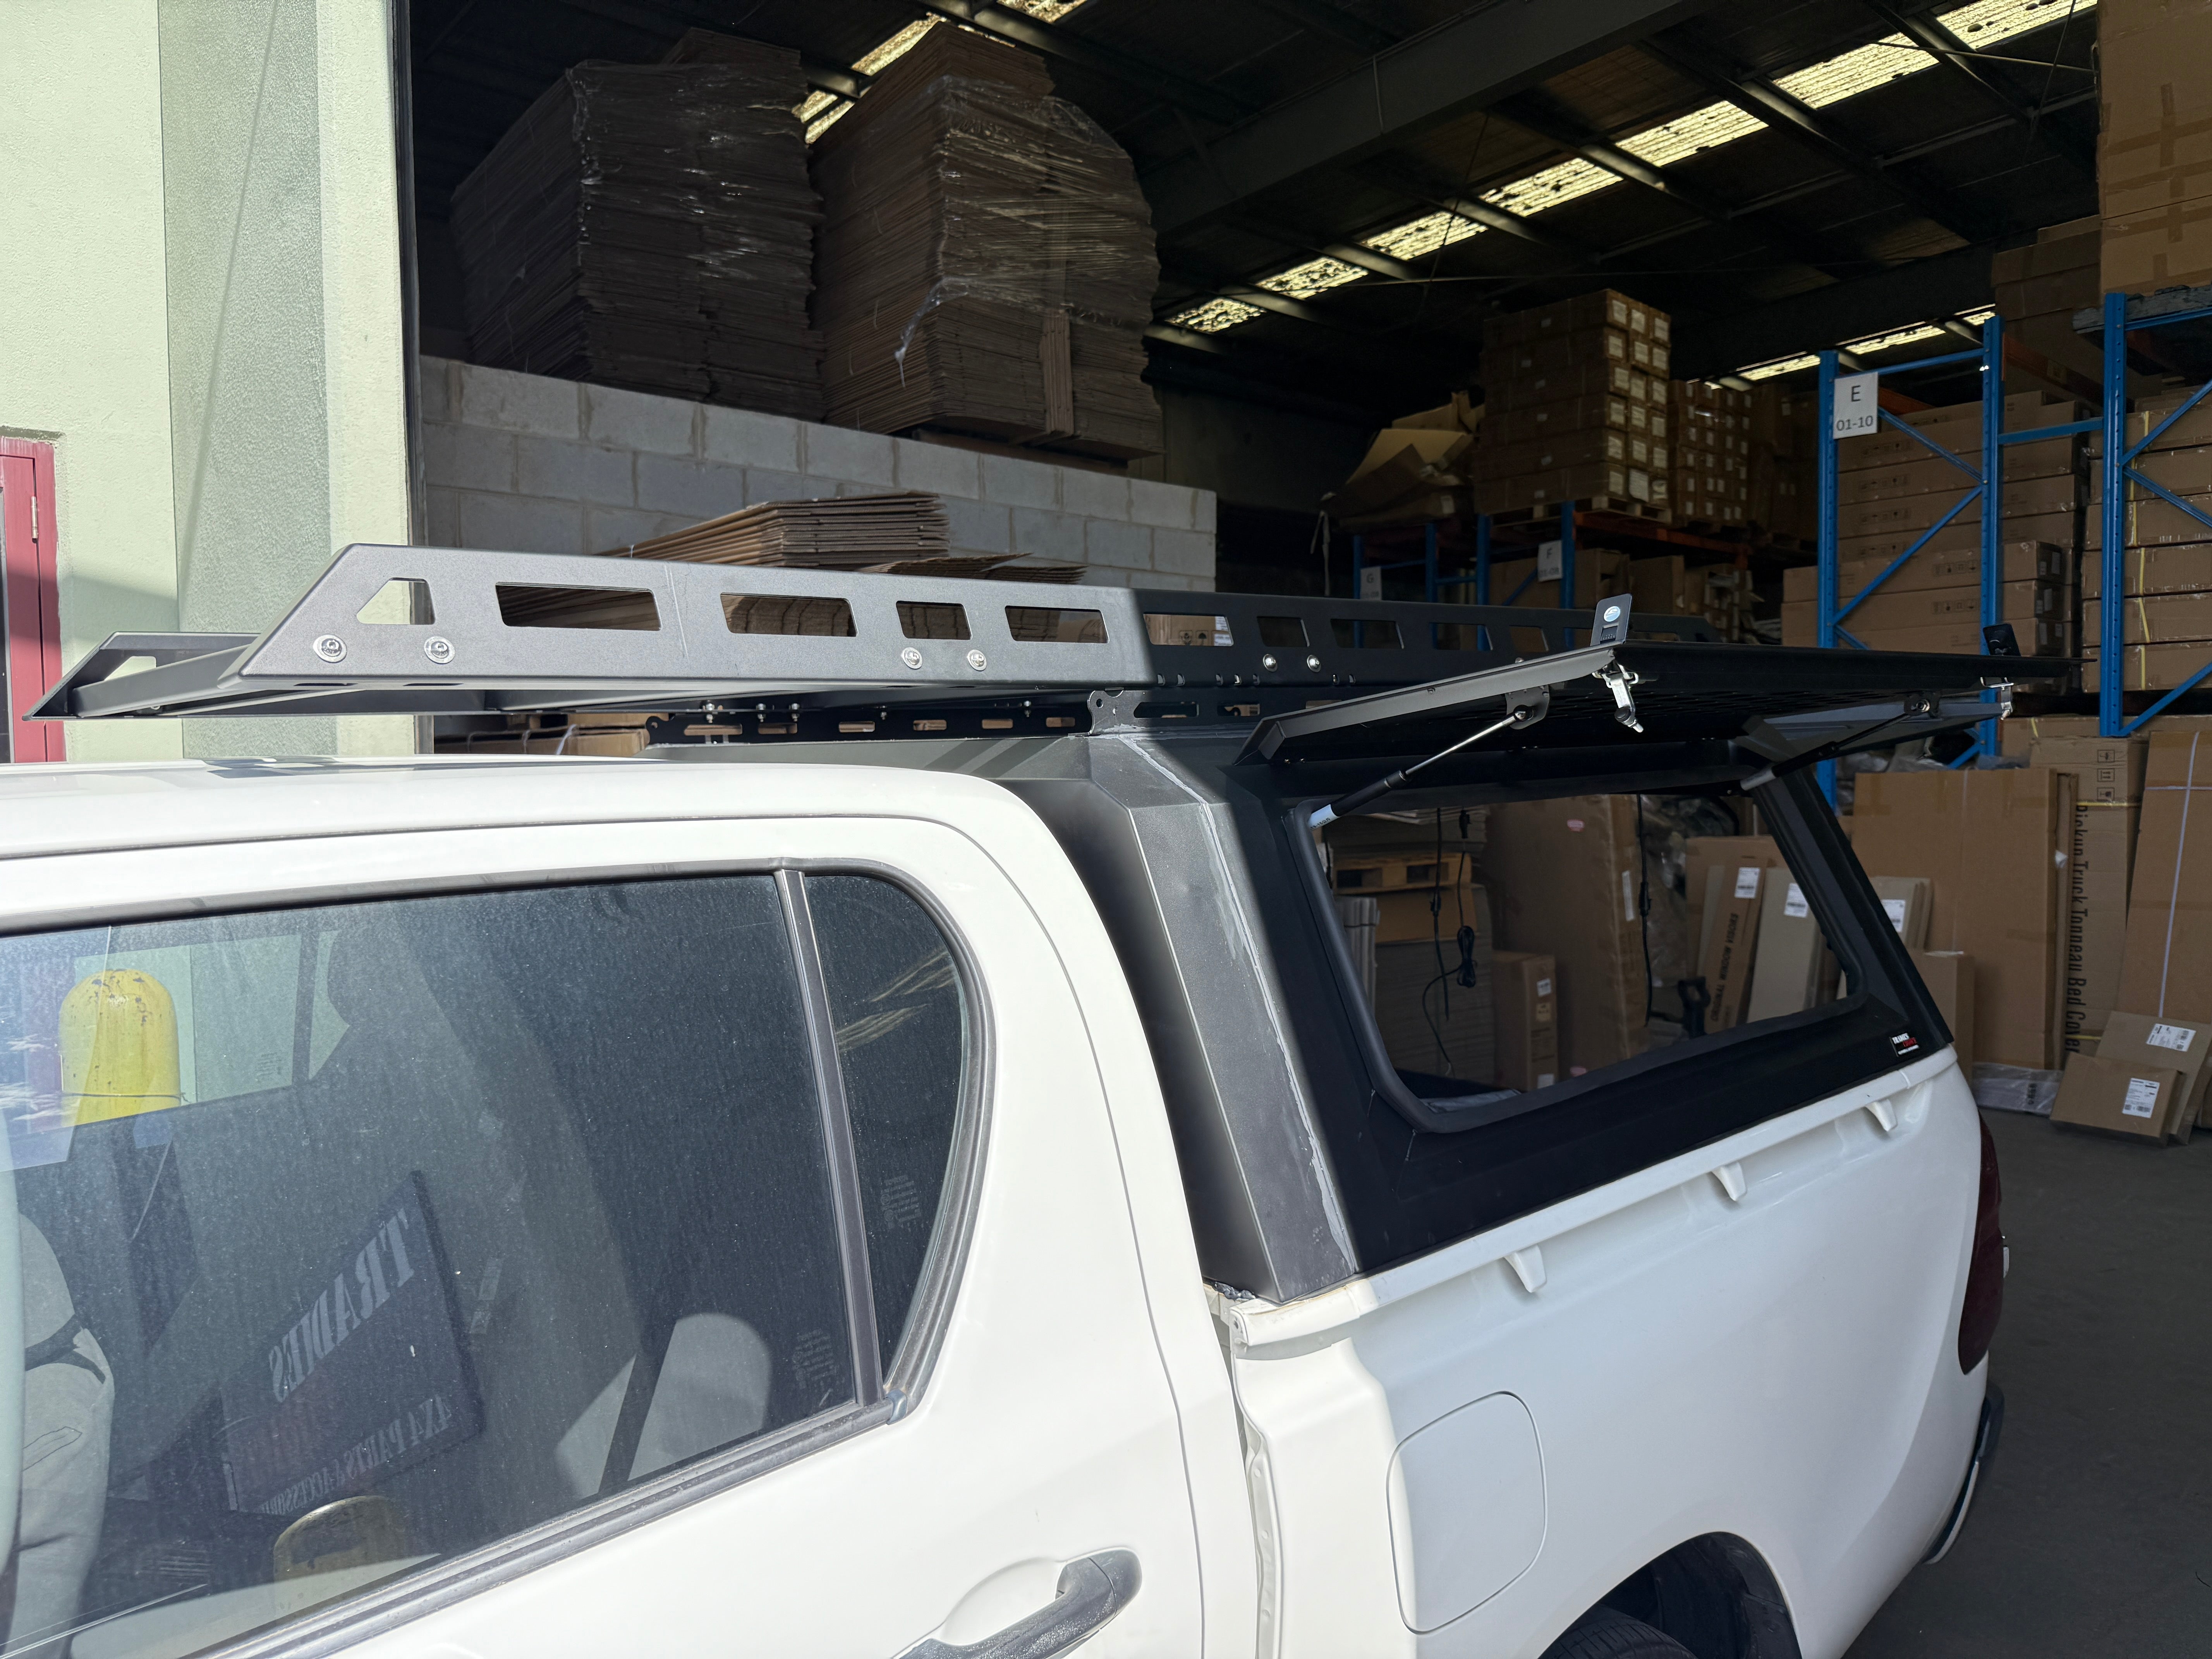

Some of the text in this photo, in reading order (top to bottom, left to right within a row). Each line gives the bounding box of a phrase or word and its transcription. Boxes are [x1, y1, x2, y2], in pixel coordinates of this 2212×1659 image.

[1851, 385, 1861, 402] E
[1836, 415, 1873, 431] 01-10
[2072, 861, 2088, 903] Truck
[2068, 909, 2088, 971] Tonneau
[2067, 978, 2087, 1005] Bed
